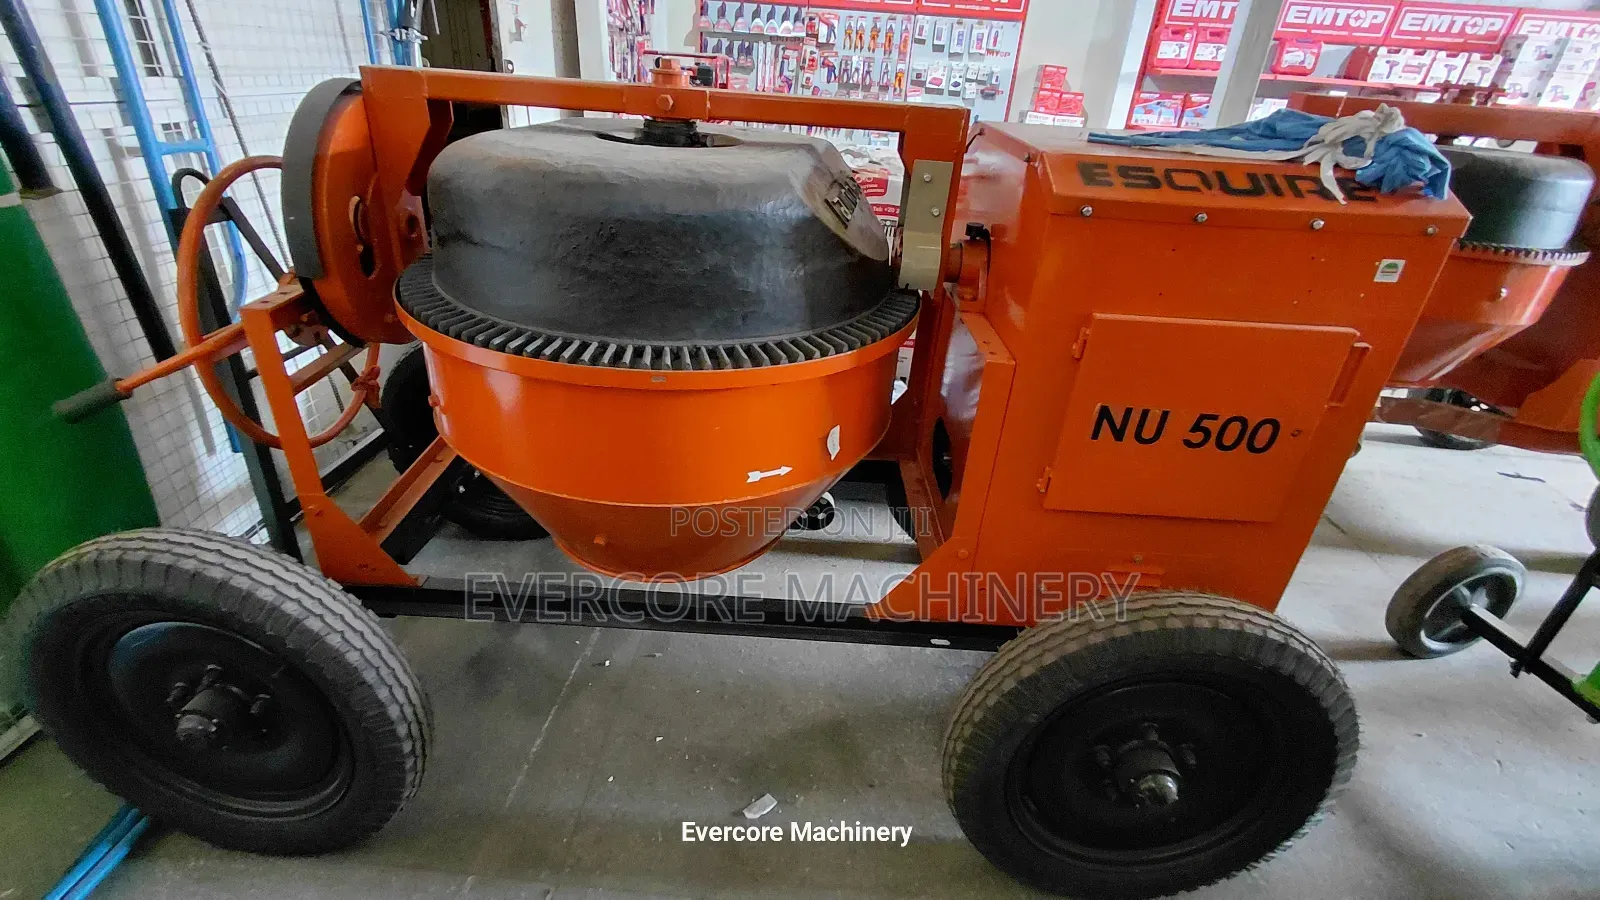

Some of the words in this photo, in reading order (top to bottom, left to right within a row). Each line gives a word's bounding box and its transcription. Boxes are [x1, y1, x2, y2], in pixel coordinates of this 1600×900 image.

[1171, 0, 1239, 19] EMT
[1284, 5, 1387, 28] EMTOP
[1399, 12, 1505, 35] EMTOP
[1076, 161, 1378, 202] ESQUIRE
[1090, 404, 1171, 445] NU
[1182, 413, 1281, 454] 500
